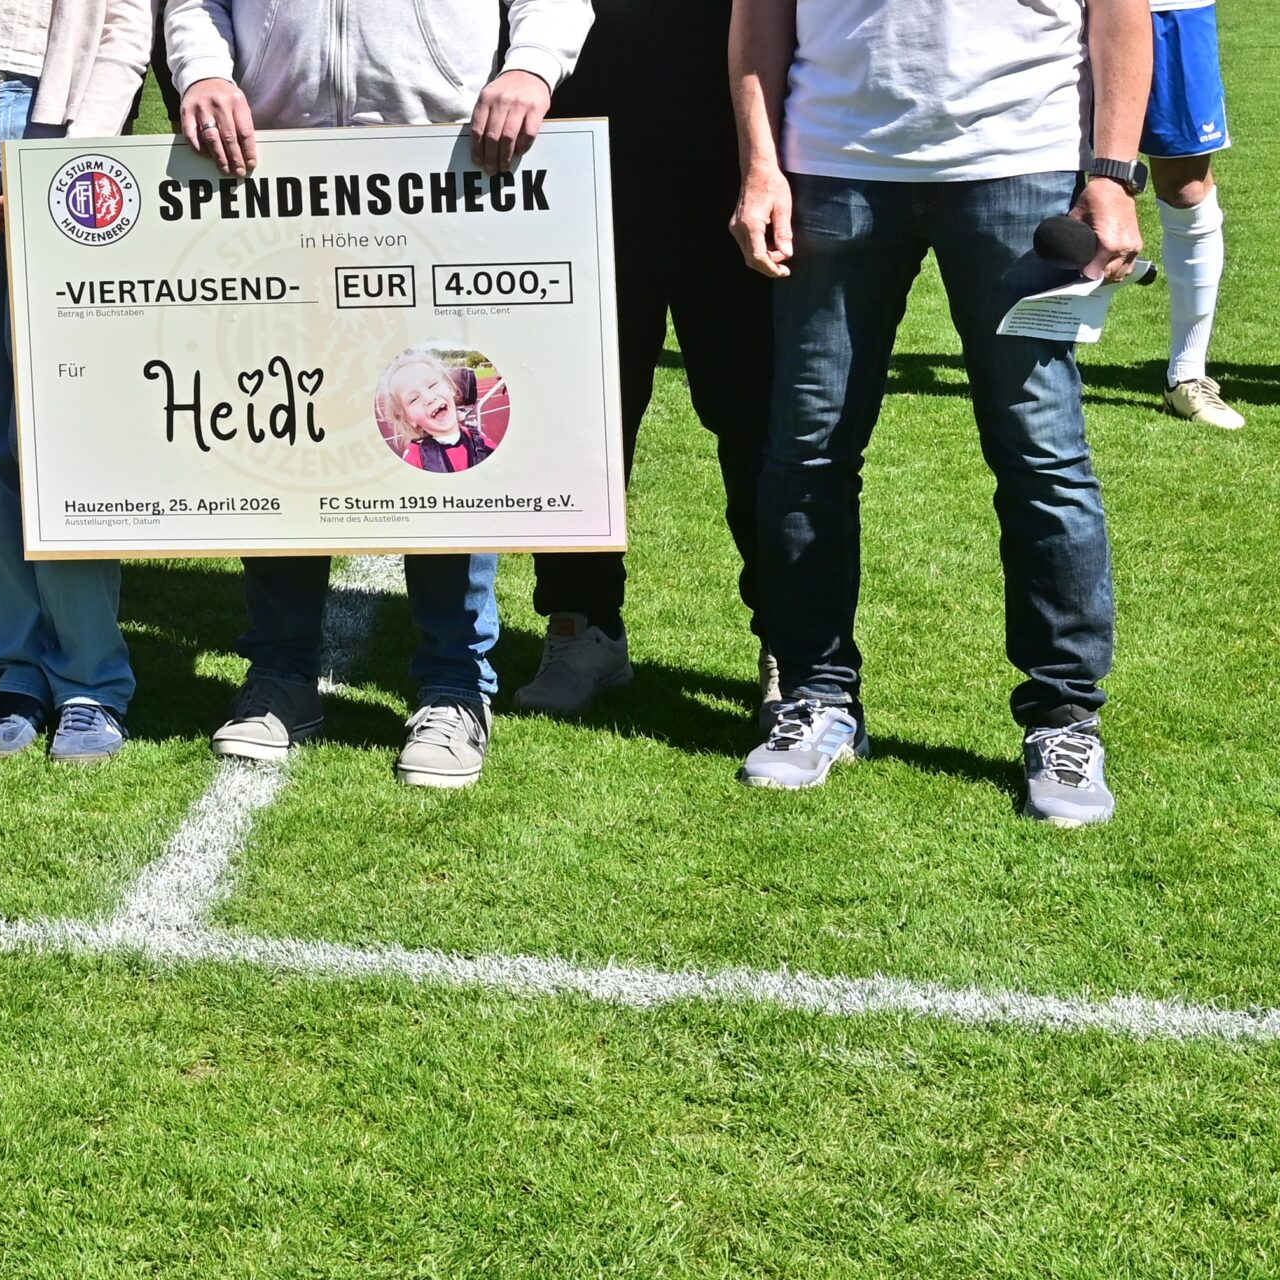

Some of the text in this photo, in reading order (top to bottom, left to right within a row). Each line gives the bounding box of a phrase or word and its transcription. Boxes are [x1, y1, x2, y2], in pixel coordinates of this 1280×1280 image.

[56, 160, 132, 193] FC STURM 1919
[158, 170, 550, 221] SPENDENSCHECK
[61, 216, 130, 242] HAUZENBERG
[300, 232, 407, 248] in Höhe von
[56, 276, 300, 304] -VIERTAUSEND-
[343, 274, 407, 298] EUR
[444, 270, 560, 300] 4.000,-
[57, 308, 144, 319] Betrag in Buchstaben
[434, 307, 510, 318] Betrag: Euro, Cent
[58, 363, 86, 378] Für
[143, 356, 325, 452] Heidi
[64, 498, 280, 516] Hauzenberg, 25. April 2026
[320, 494, 575, 511] FC Sturm 1919 Hauzenberg e.V.
[64, 517, 161, 526] Ausstellungsort, Datum
[320, 514, 410, 523] Name des Ausstellers
